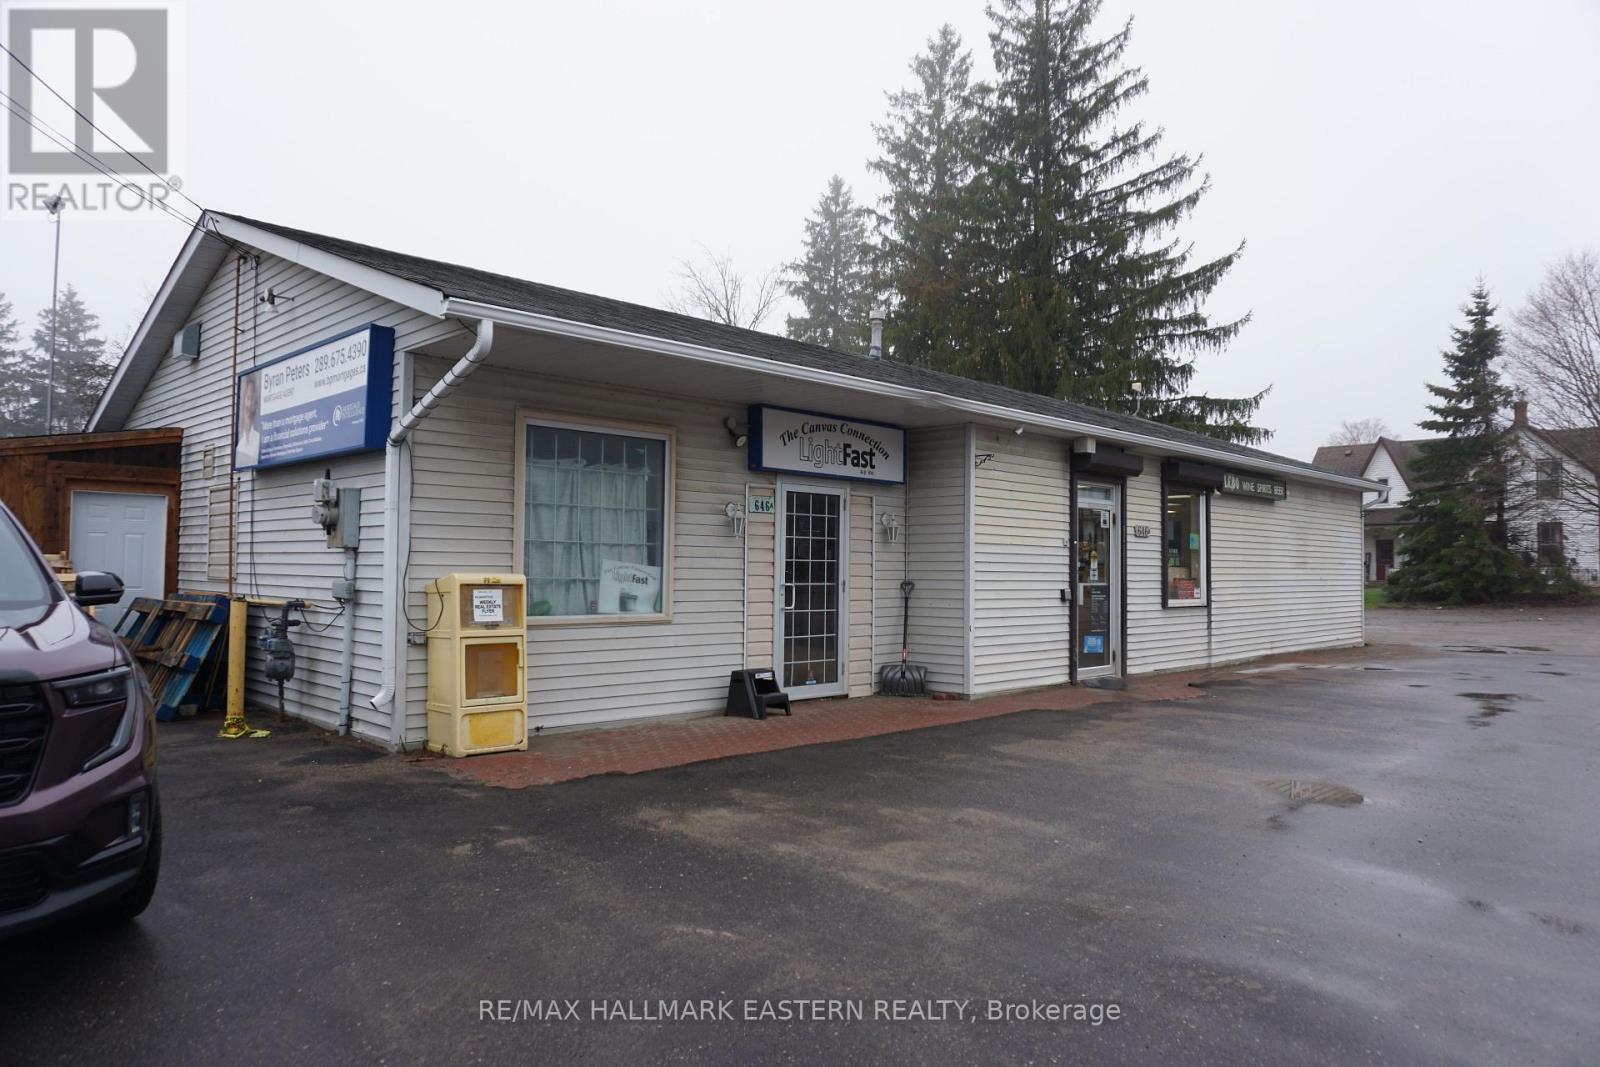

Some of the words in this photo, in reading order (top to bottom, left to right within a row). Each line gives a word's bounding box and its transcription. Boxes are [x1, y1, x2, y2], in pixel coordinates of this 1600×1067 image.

[314, 339, 367, 373] 289.675.4390
[264, 372, 284, 393] Byran
[286, 364, 310, 384] Peters
[779, 429, 798, 447] The
[801, 422, 837, 435] Canvas
[840, 422, 890, 460] Connection
[1242, 481, 1255, 492] WINE
